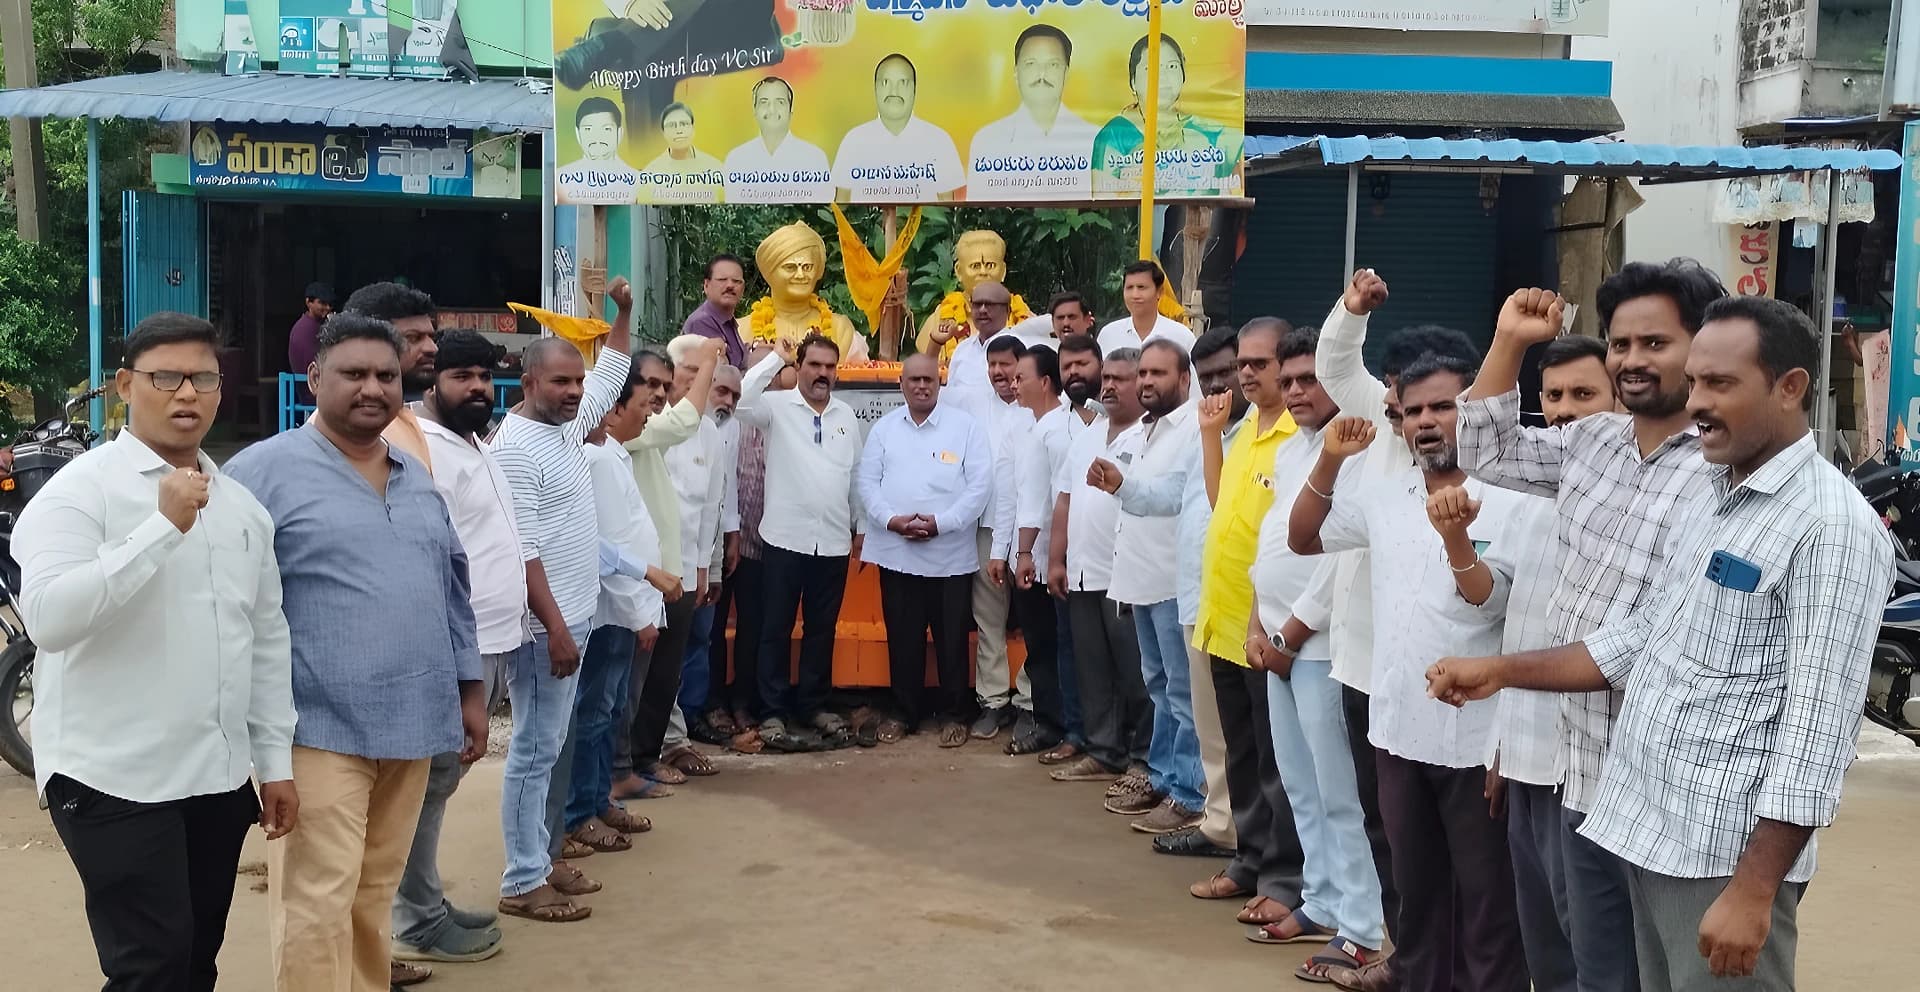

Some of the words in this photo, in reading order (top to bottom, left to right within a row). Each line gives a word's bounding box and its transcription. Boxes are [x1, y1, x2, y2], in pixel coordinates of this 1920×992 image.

[645, 55, 686, 80] Birth
[690, 53, 717, 78] day
[750, 46, 775, 68] Sir
